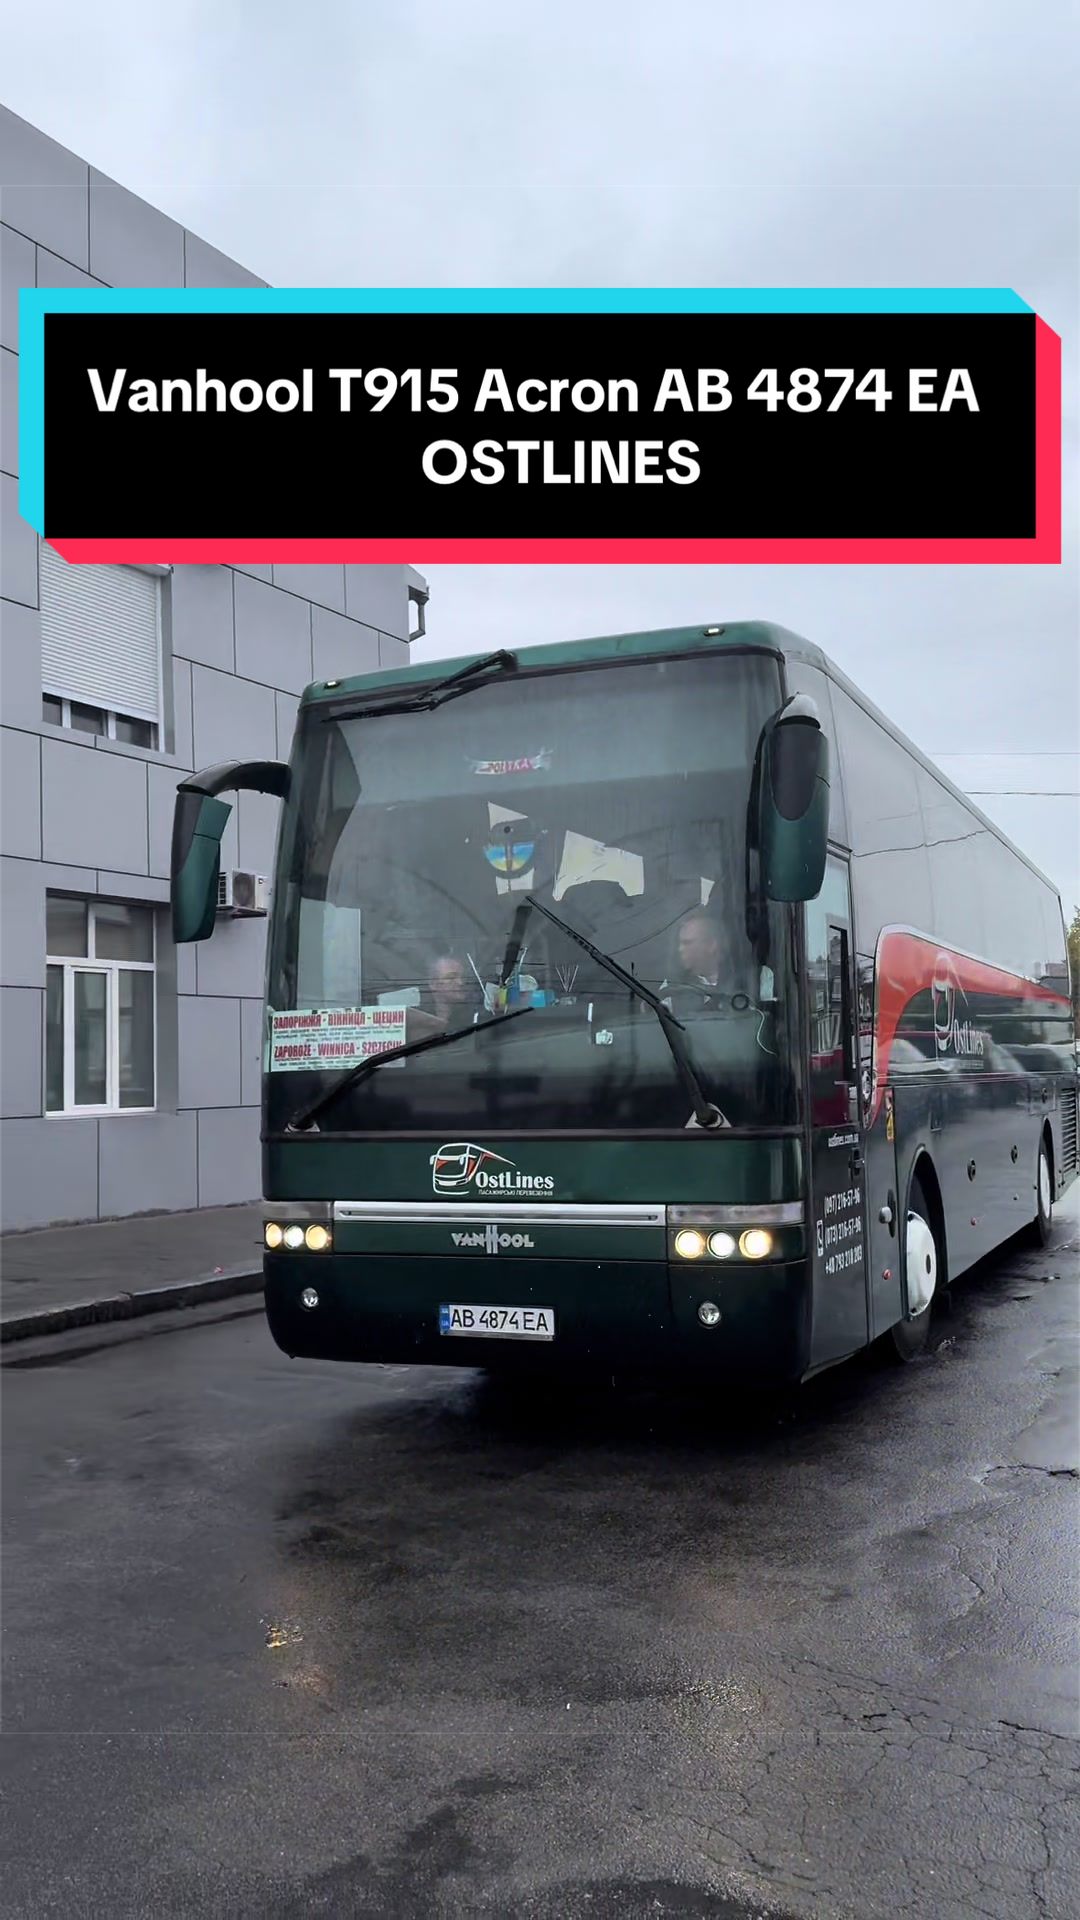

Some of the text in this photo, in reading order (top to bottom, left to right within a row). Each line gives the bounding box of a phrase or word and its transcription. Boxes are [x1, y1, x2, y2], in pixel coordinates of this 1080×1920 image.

[274, 1014, 321, 1029] ЗАПОРІЖЖЯ
[954, 1019, 983, 1056] OstLines
[318, 1042, 355, 1056] WINNICA
[475, 1171, 554, 1189] OstLines
[451, 1309, 548, 1331] AB 4874 EA
